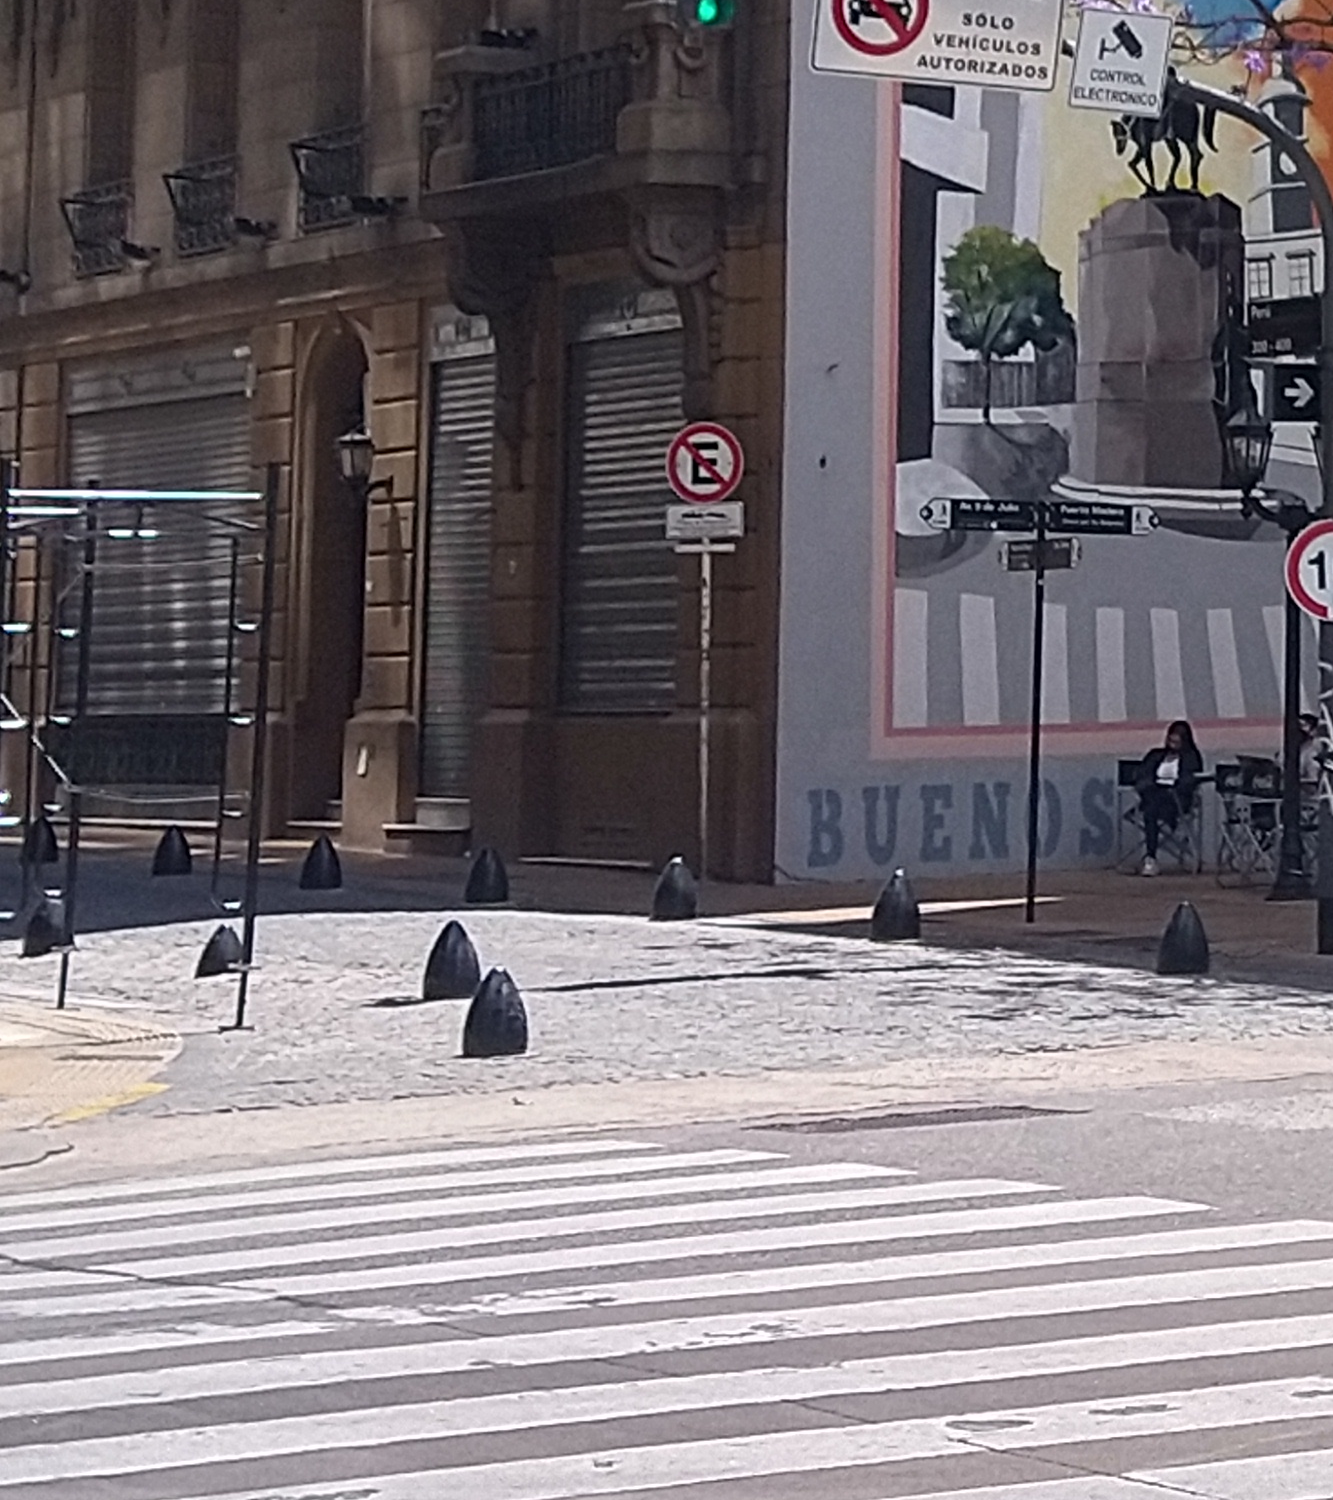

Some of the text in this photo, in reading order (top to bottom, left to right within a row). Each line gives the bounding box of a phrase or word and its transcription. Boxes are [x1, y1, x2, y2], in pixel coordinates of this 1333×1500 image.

[932, 33, 1042, 56] VEHÍCULOS
[917, 55, 1049, 80] AUTORIZADOS
[1090, 68, 1147, 87] CONTROL
[807, 776, 1117, 868] BUENOS
